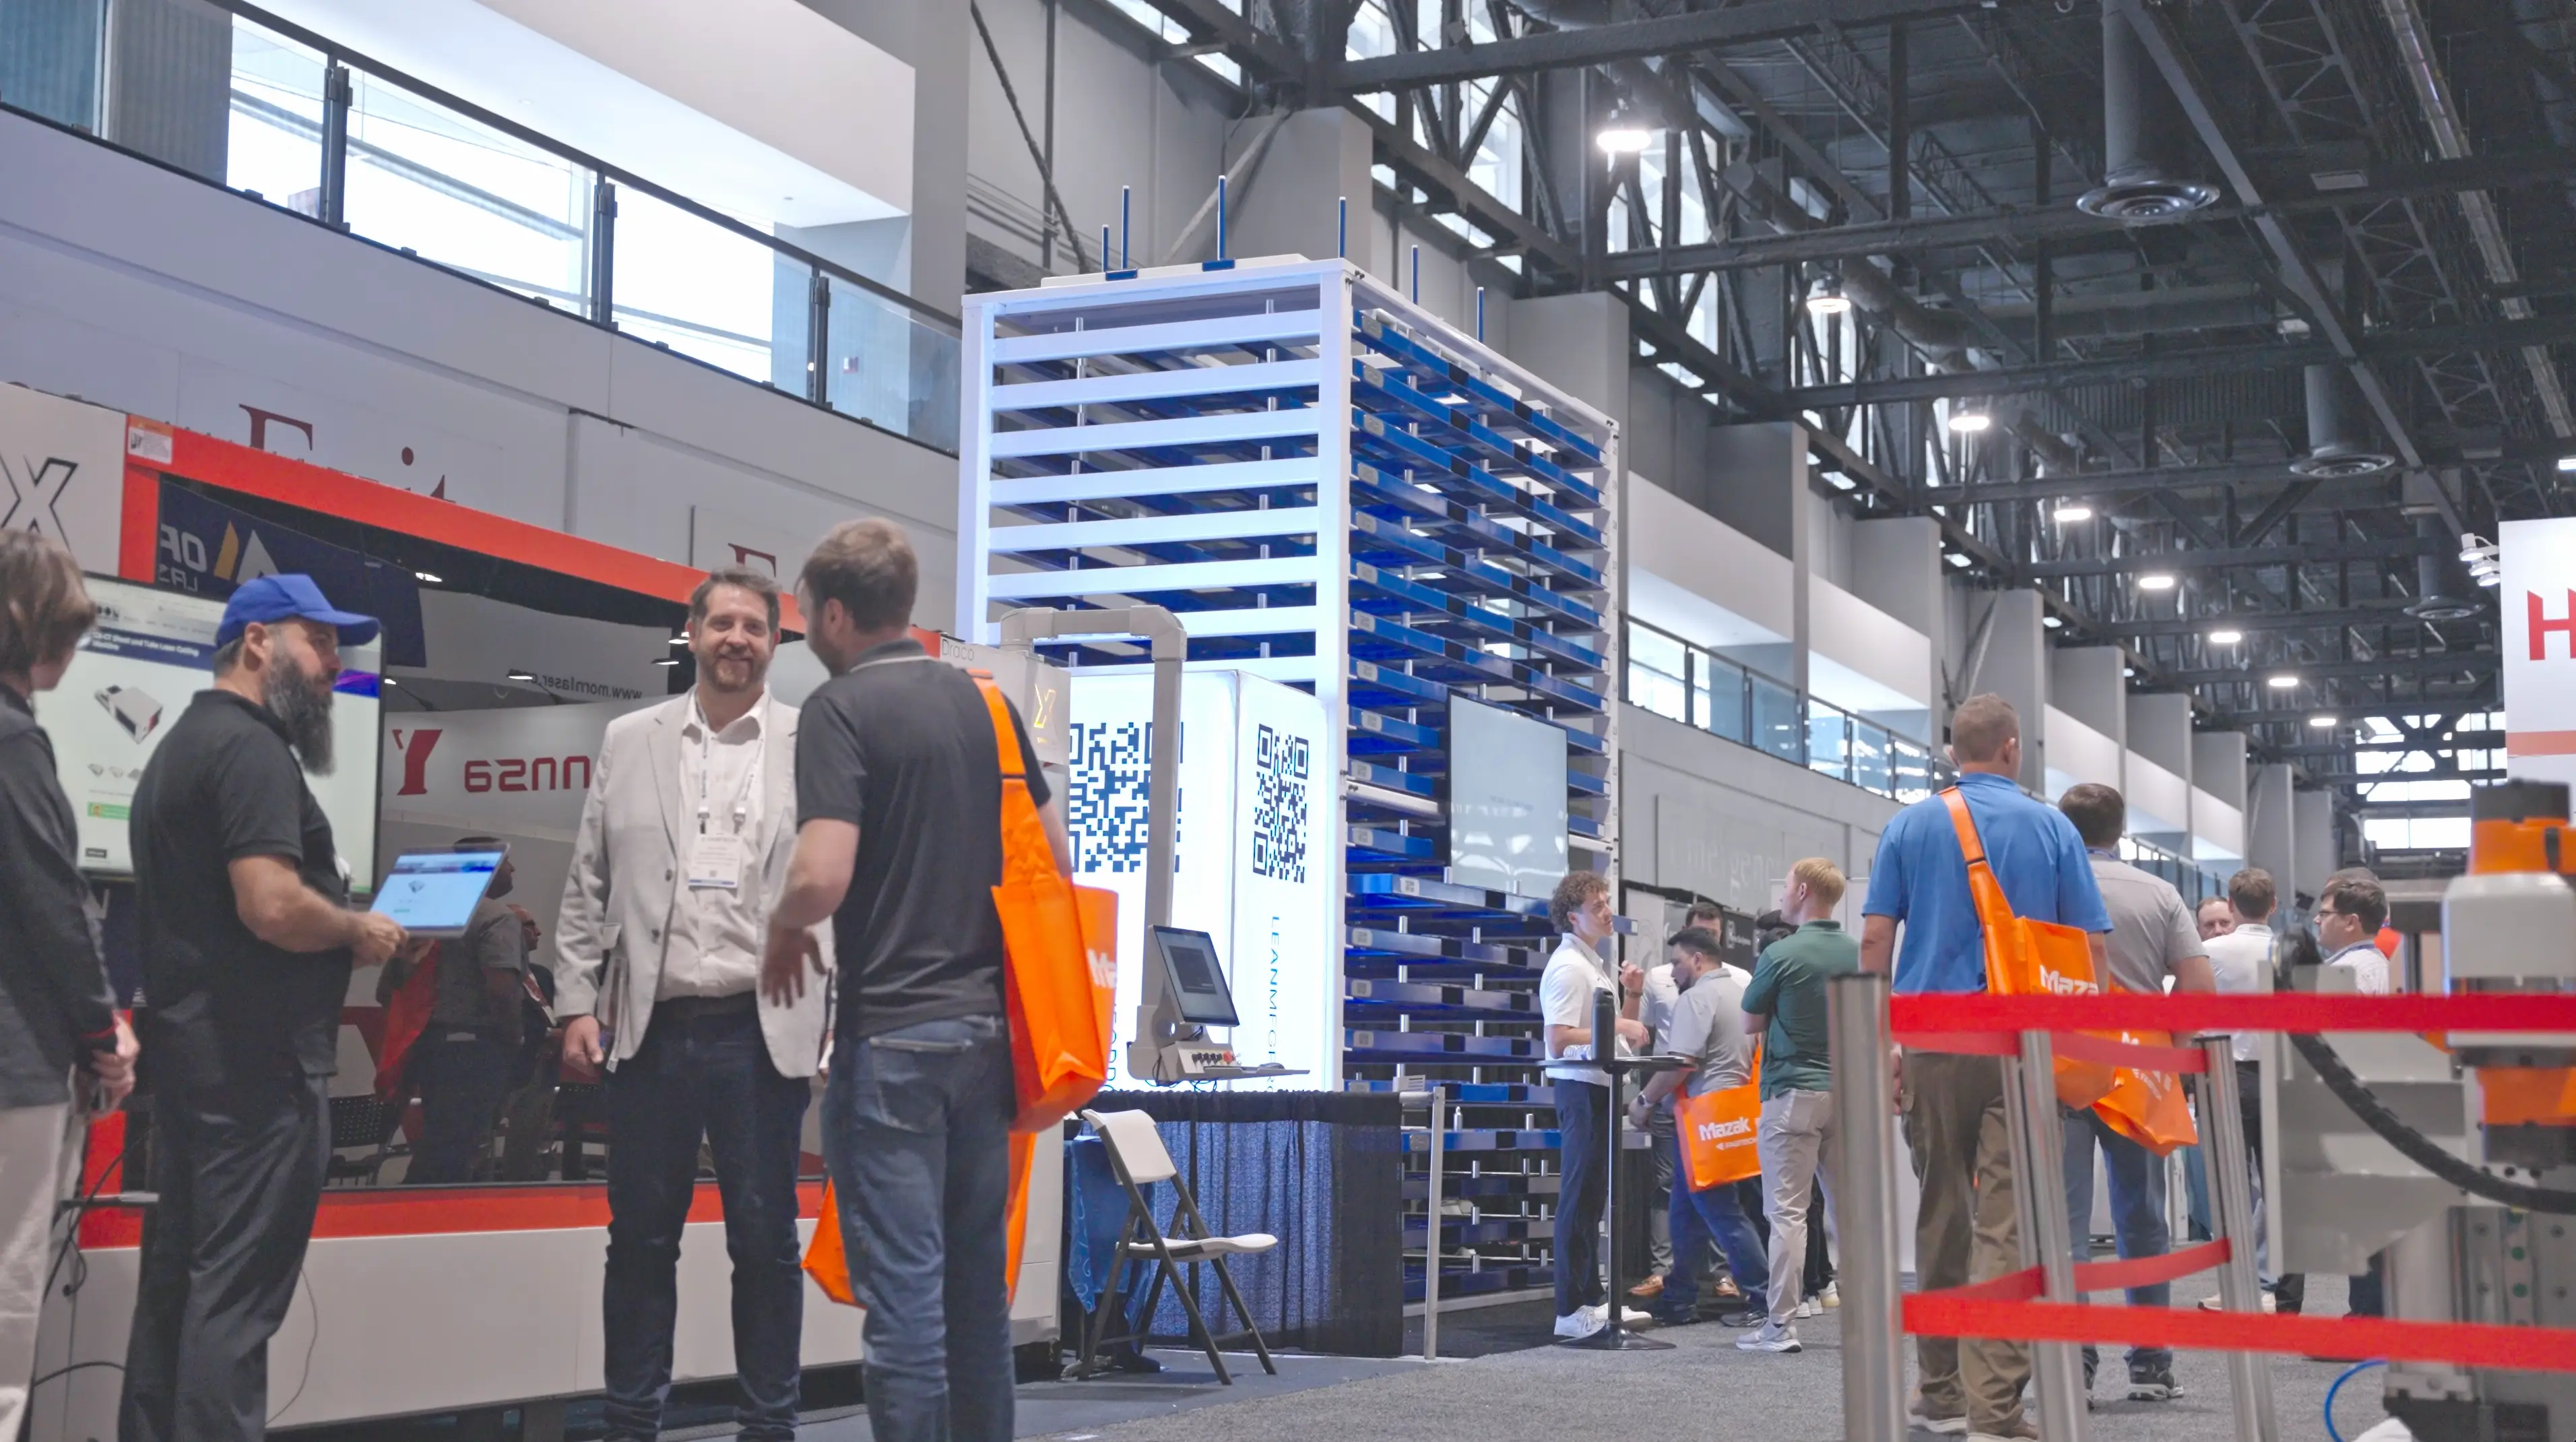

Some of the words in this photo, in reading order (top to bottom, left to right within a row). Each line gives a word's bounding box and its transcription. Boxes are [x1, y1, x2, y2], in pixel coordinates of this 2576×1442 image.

[942, 638, 975, 662] Draco
[2039, 964, 2099, 997] Maza
[1698, 1116, 1751, 1141] Mazak
